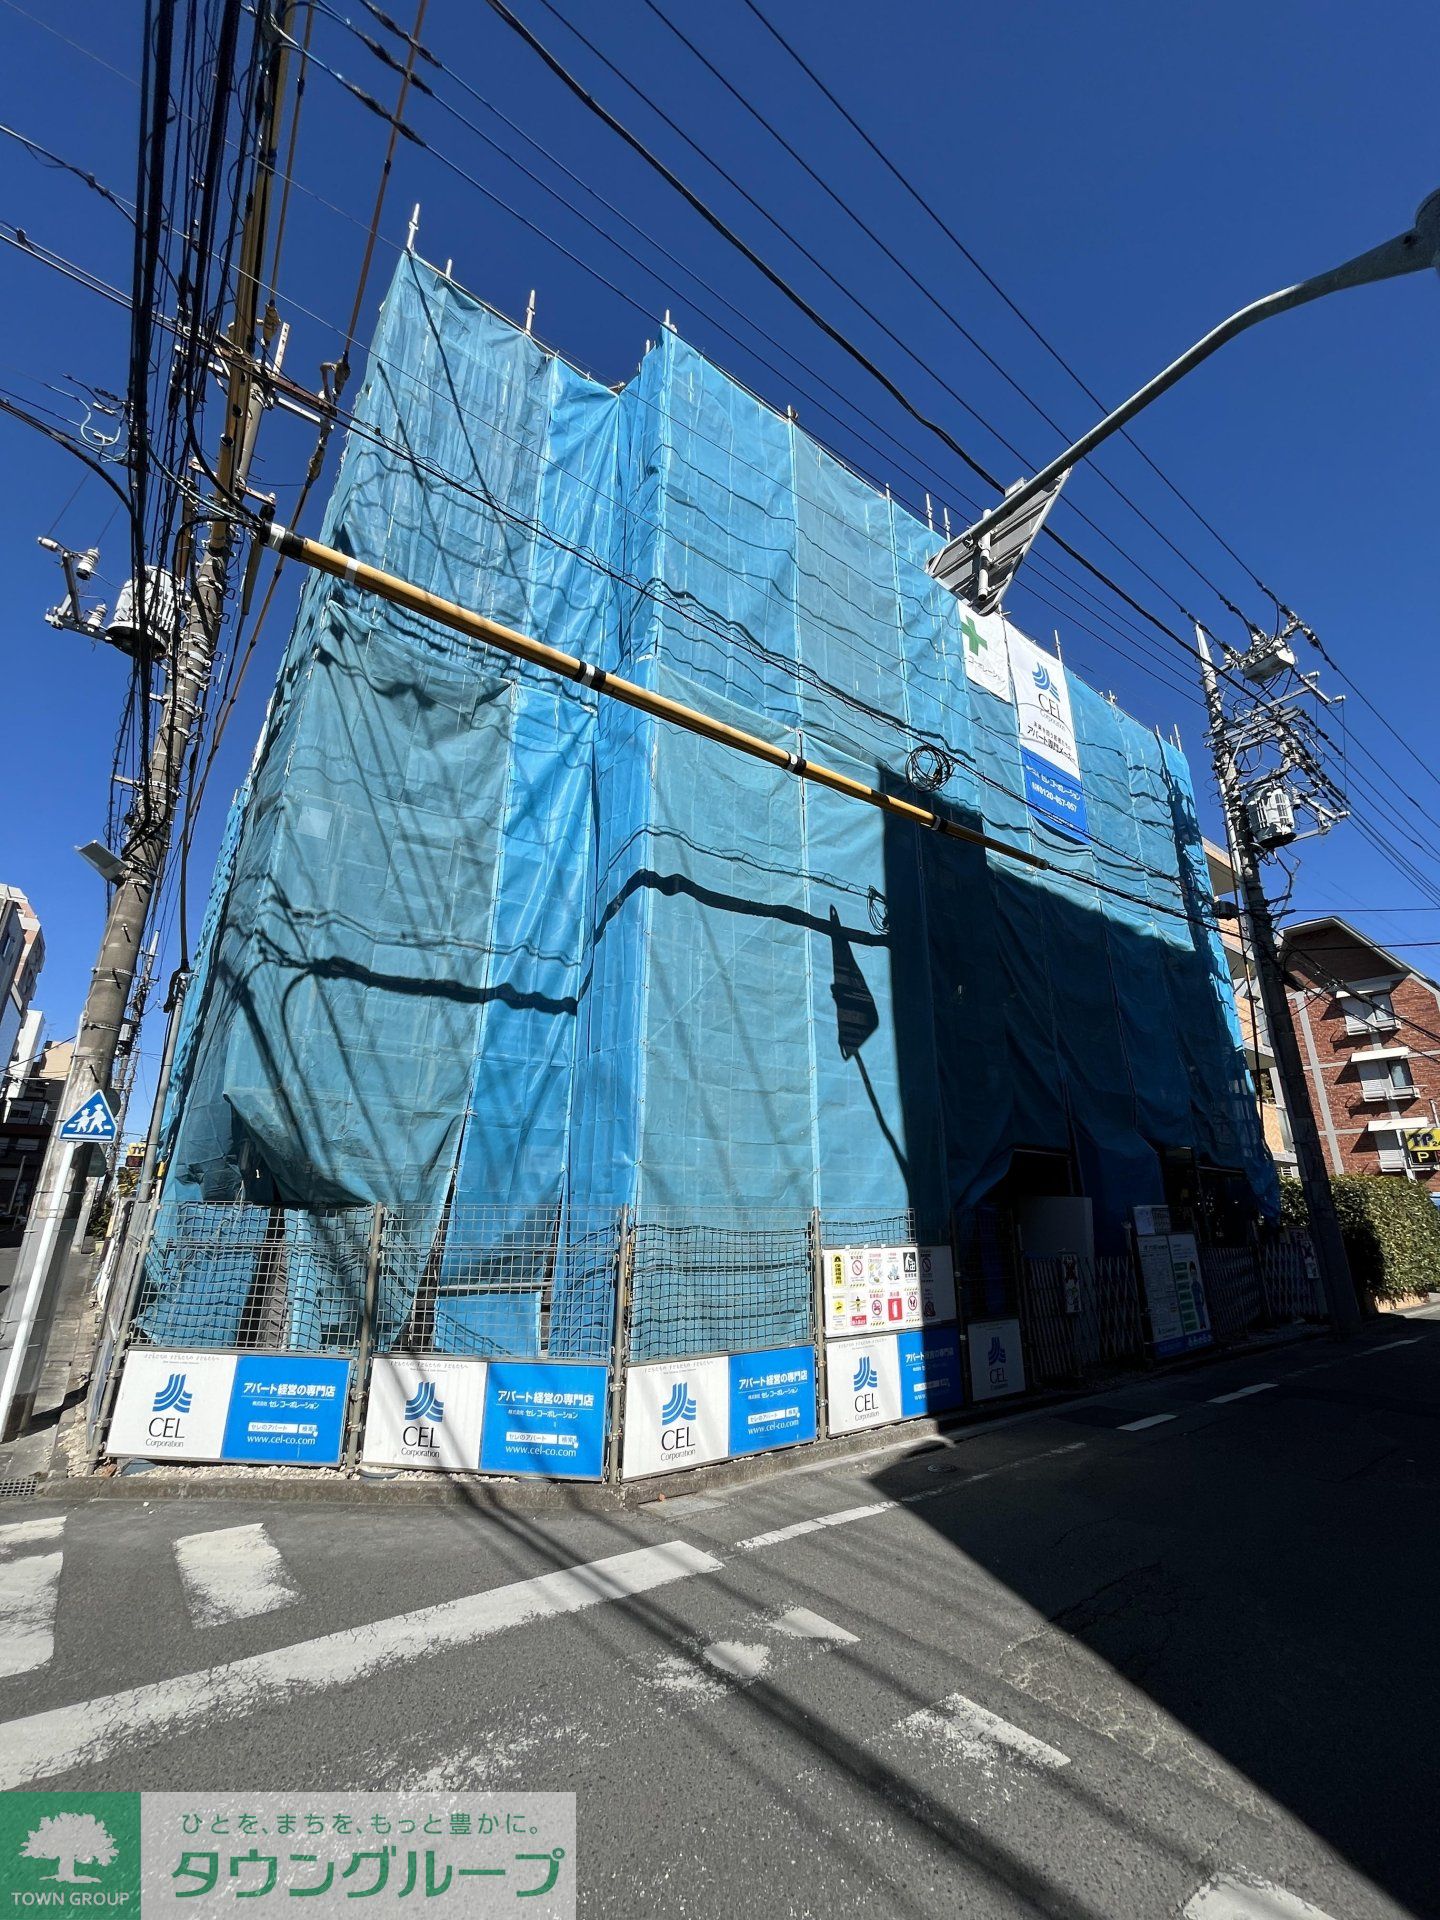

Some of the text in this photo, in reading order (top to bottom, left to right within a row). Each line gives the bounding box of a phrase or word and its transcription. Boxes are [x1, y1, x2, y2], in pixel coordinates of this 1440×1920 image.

[1038, 693, 1063, 721] CEL
[1417, 1151, 1429, 1163] P
[989, 1368, 1009, 1384] CEL
[243, 1382, 336, 1398] アパート経営の専門店
[497, 1391, 594, 1407] アパート経営の専門店
[854, 1392, 879, 1413] CEL
[149, 1417, 185, 1438] CEL
[145, 1438, 184, 1448] Corporation
[247, 1434, 315, 1445] www.cel-co.com
[402, 1426, 440, 1449] CEL
[661, 1428, 695, 1451] CEL
[401, 1447, 440, 1458] Corporation
[505, 1445, 576, 1457] www.cel-co.com
[660, 1449, 695, 1461] Corporation
